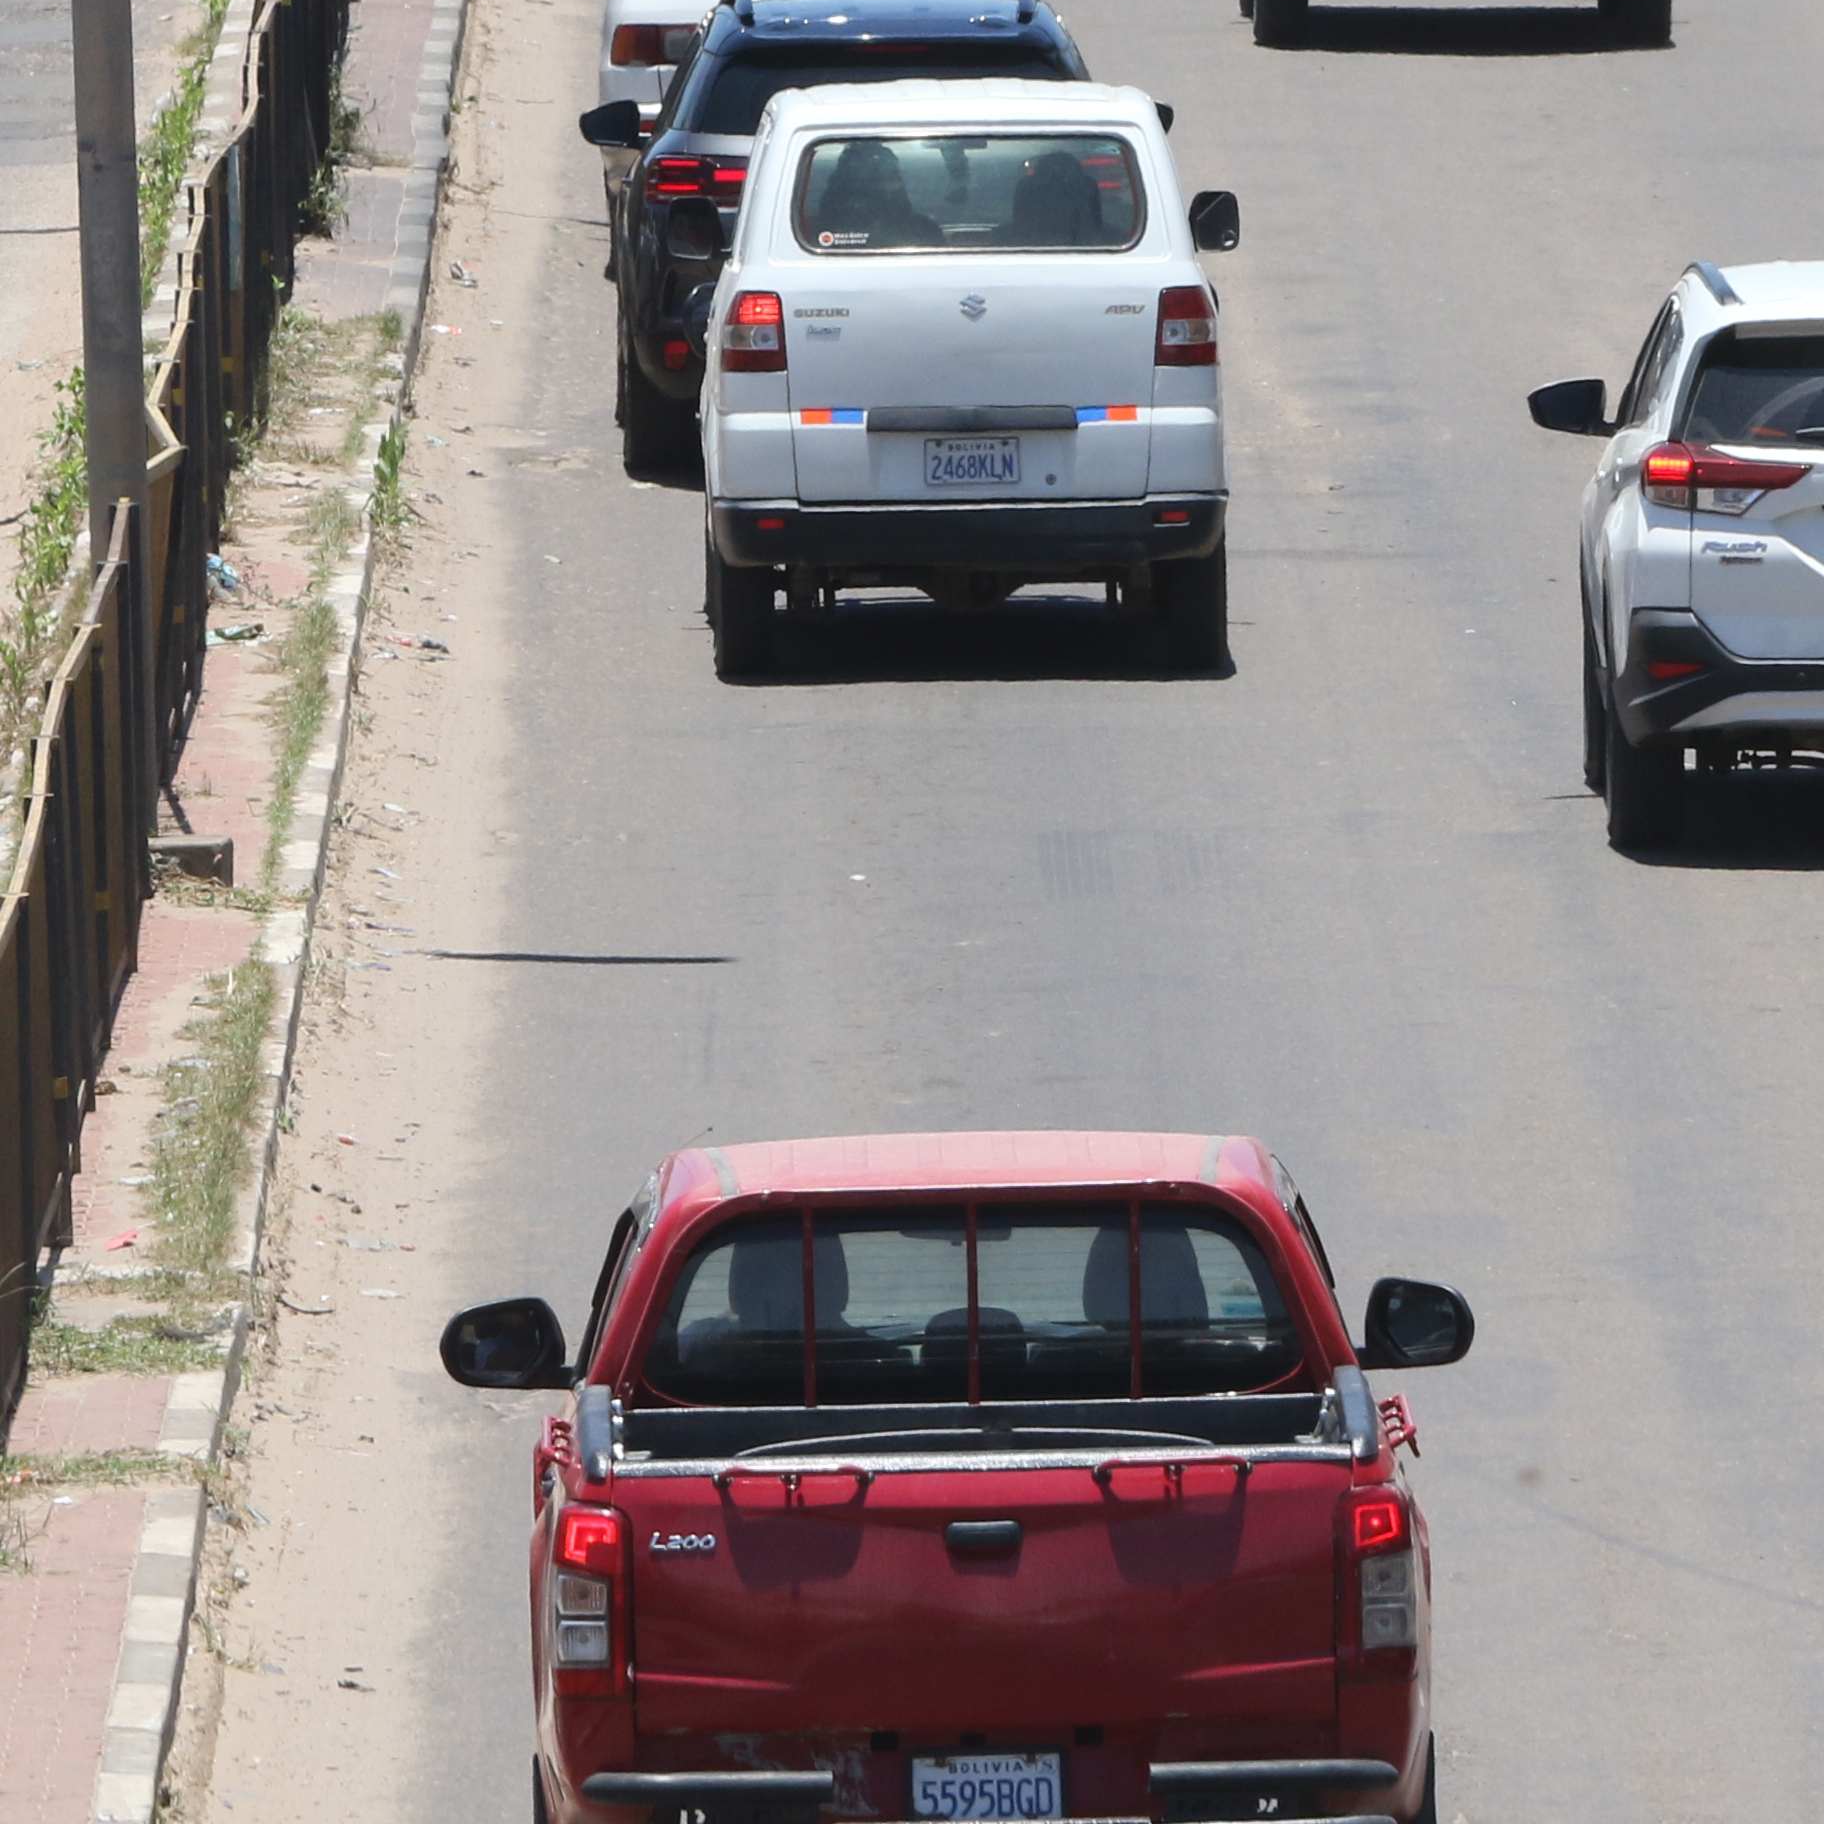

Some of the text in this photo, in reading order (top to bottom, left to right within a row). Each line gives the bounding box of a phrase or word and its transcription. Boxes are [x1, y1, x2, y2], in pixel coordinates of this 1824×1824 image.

[793, 307, 850, 317] SUZUKI
[1105, 304, 1146, 315] APV
[931, 454, 1013, 480] 2468KLN
[650, 1531, 716, 1551] L200
[948, 1761, 1024, 1775] BOLIVIA
[921, 1778, 1054, 1818] 5595BGD
